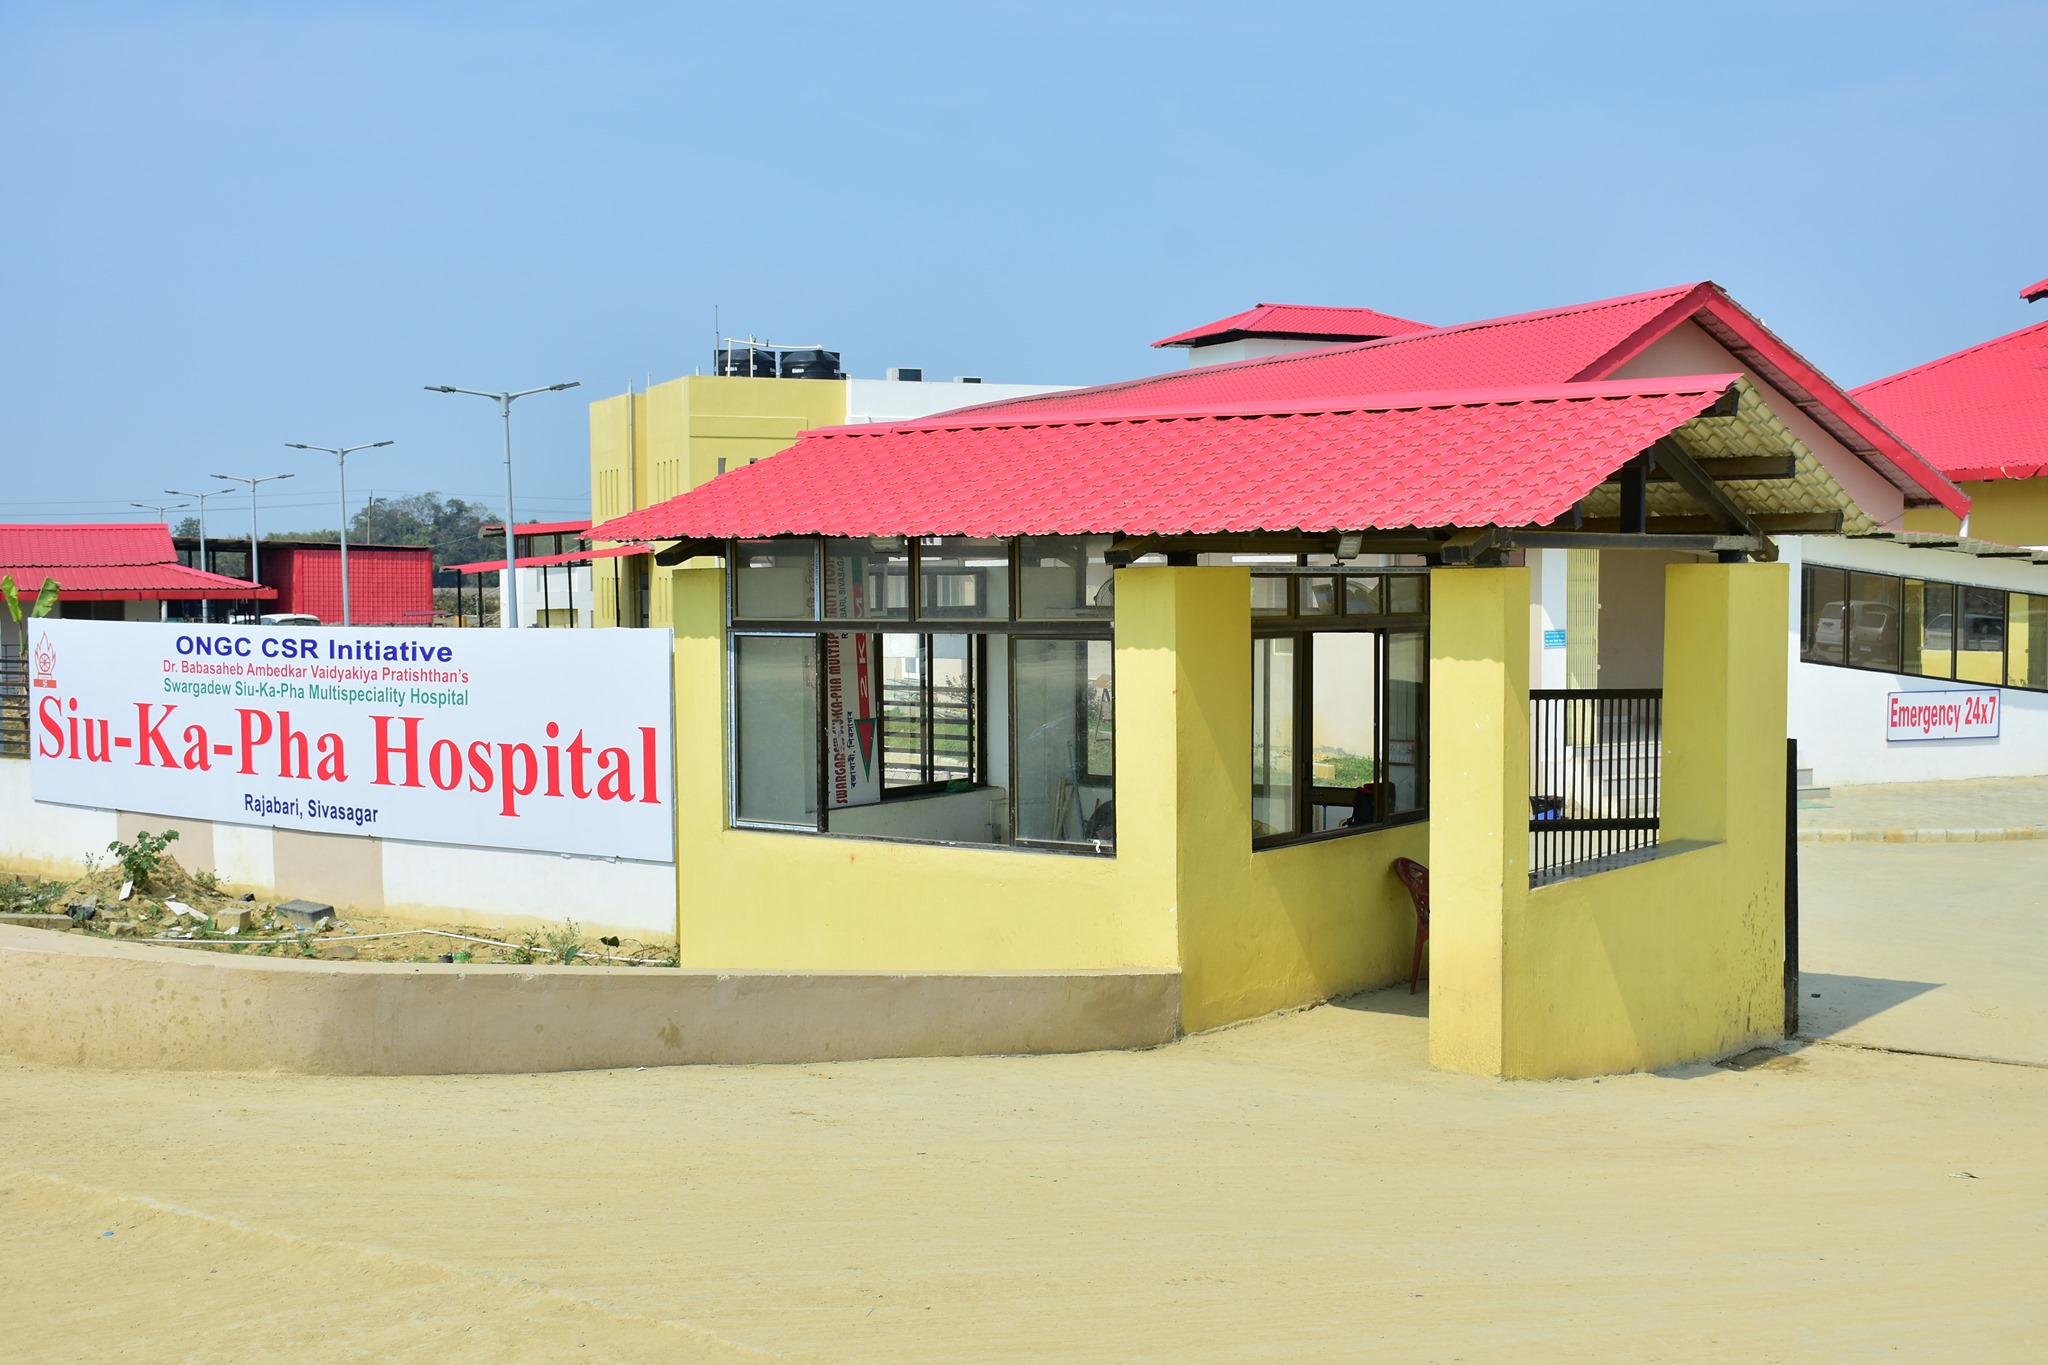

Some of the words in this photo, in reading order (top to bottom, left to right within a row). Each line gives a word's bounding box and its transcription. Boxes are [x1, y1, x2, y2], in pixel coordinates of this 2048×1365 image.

[175, 635, 252, 656] ONGC
[261, 638, 319, 659] CSR
[329, 639, 453, 663] Initiative
[163, 659, 178, 673] Dr.
[181, 660, 243, 675] Babasaheb
[247, 662, 307, 678] Ambedkar
[311, 665, 378, 683] Vaidyakiya
[382, 667, 469, 683] Pratishthan’s
[860, 675, 868, 698] 2
[164, 677, 231, 697] Swargadew
[235, 681, 305, 700] Siu-Ka-Pha
[309, 684, 406, 707] Multispeciality
[410, 688, 468, 708] Hospital
[1891, 697, 1961, 734] Emergency
[1964, 696, 1996, 725] 24x7
[38, 695, 349, 783] Siu-Ka-Pha
[370, 715, 661, 818] Hospital
[244, 793, 303, 819] Rajabari,
[307, 799, 379, 826] Sivasagar
